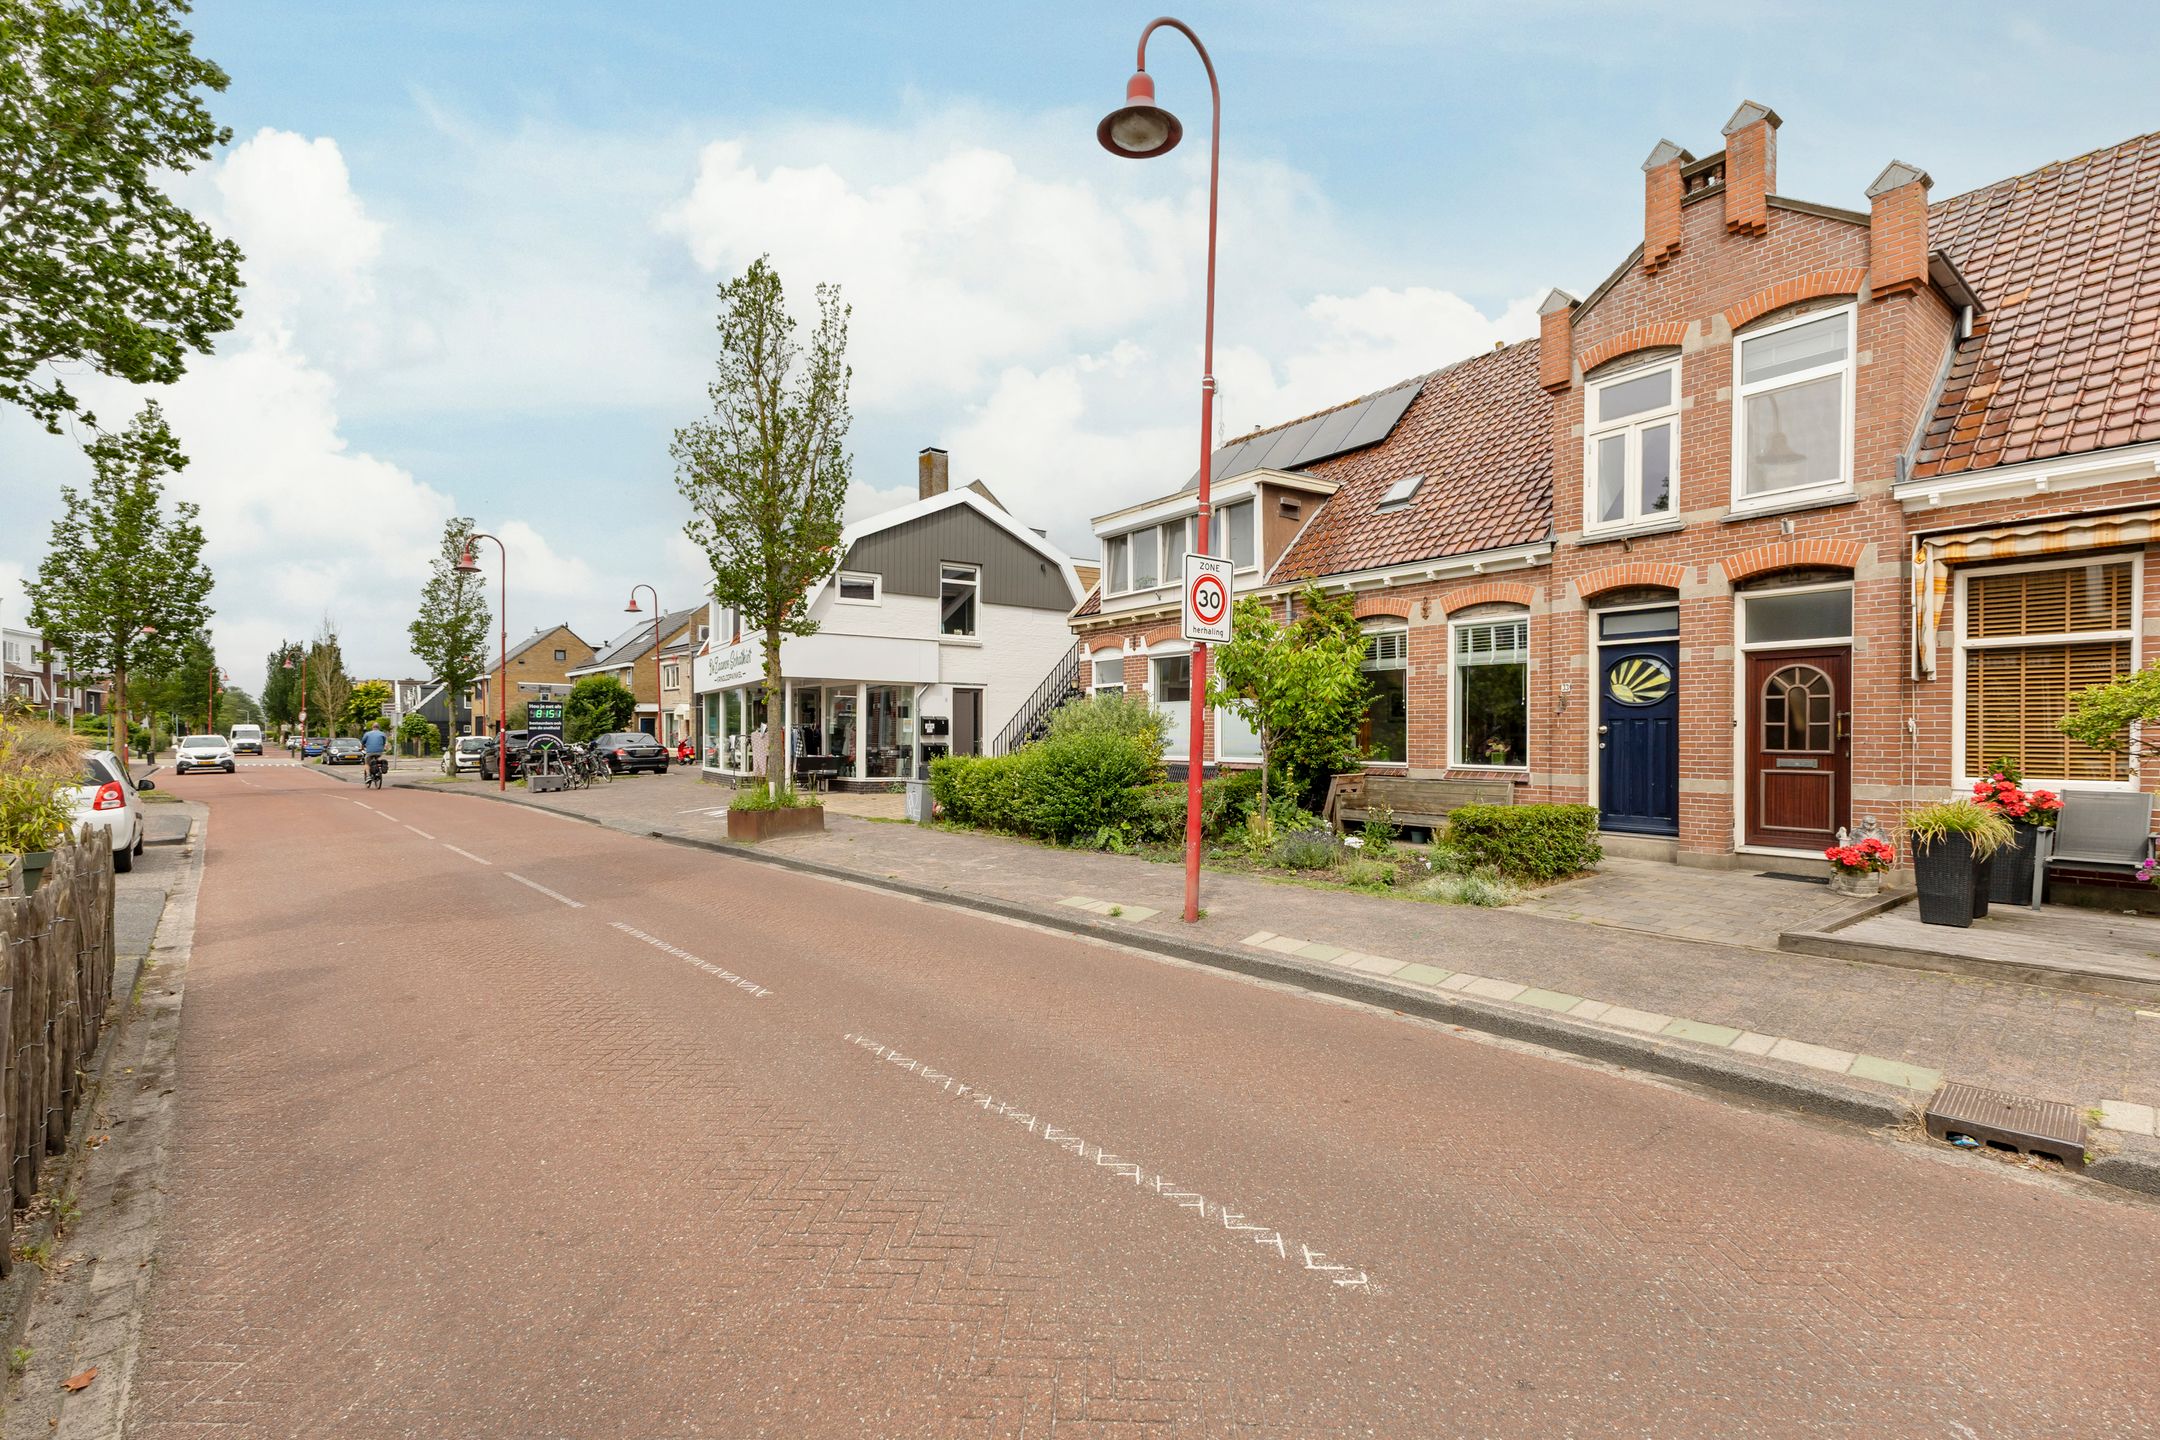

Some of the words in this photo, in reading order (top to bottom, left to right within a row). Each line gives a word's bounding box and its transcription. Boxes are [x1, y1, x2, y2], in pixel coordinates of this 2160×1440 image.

[1200, 562, 1220, 572] ZONE
[1198, 589, 1221, 610] 30
[1192, 625, 1224, 639] herhaling
